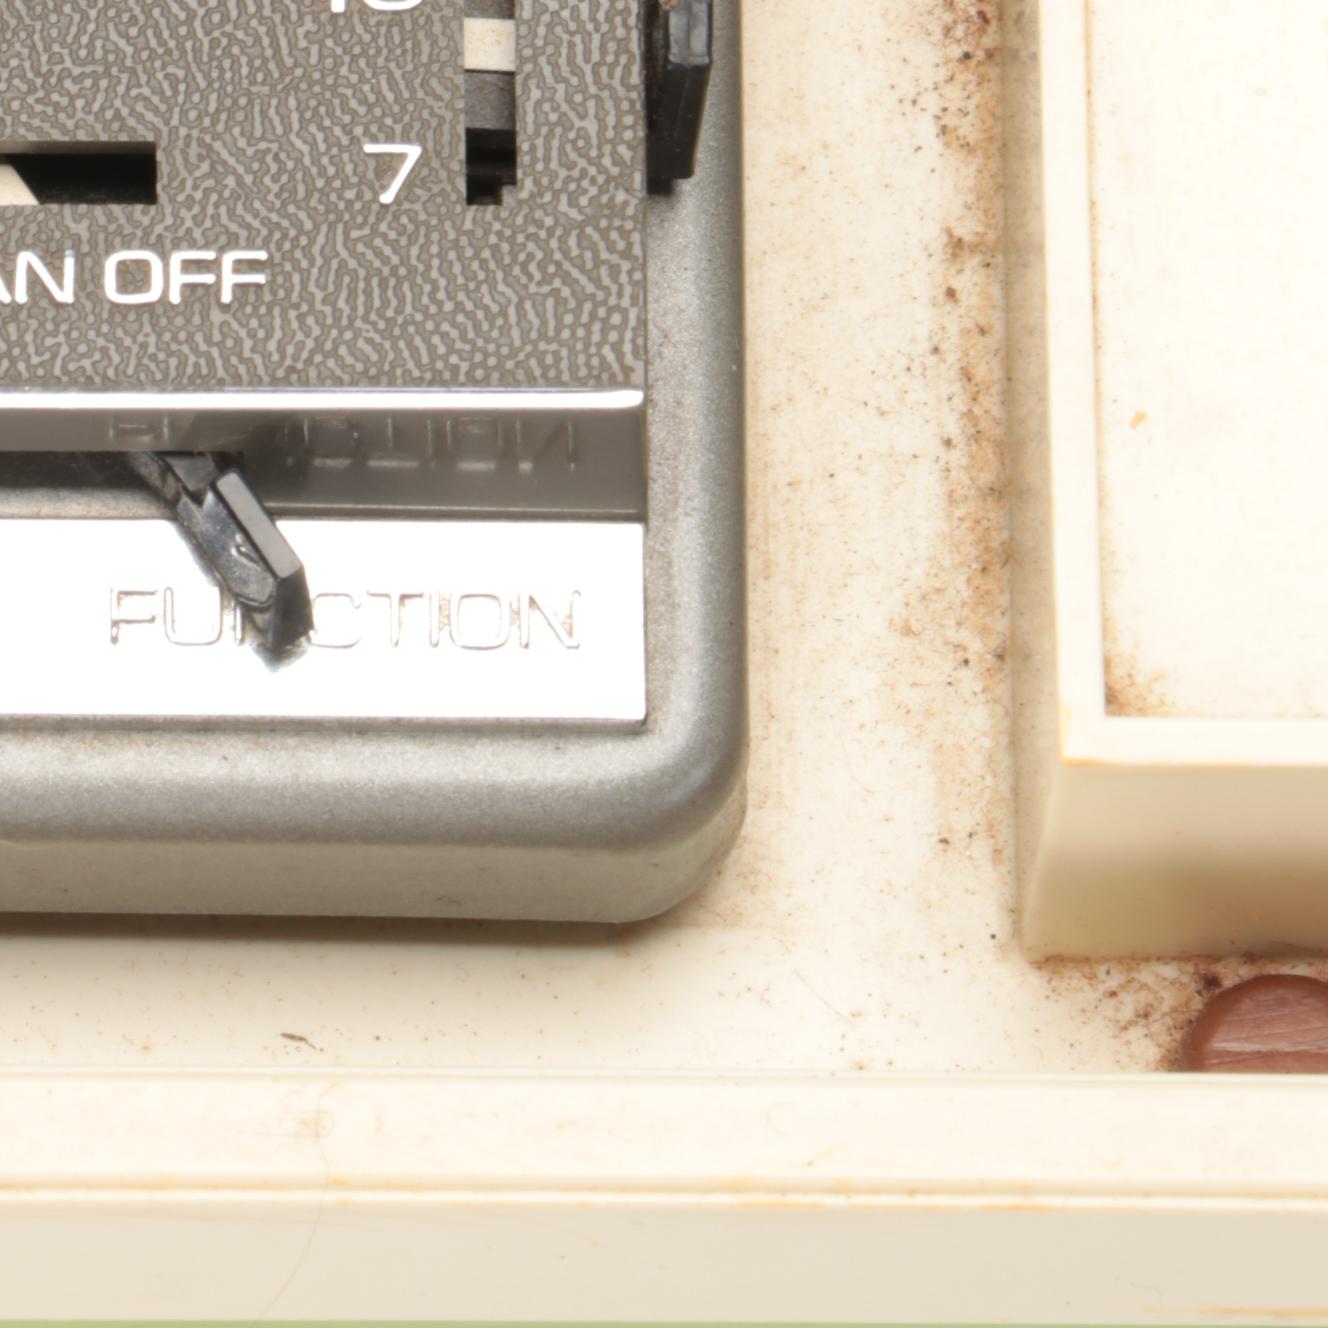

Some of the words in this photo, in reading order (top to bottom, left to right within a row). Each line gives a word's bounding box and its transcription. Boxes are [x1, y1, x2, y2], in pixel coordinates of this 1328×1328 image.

[363, 143, 422, 204] 7
[103, 249, 268, 305] OFF
[109, 586, 582, 650] FUCTION
